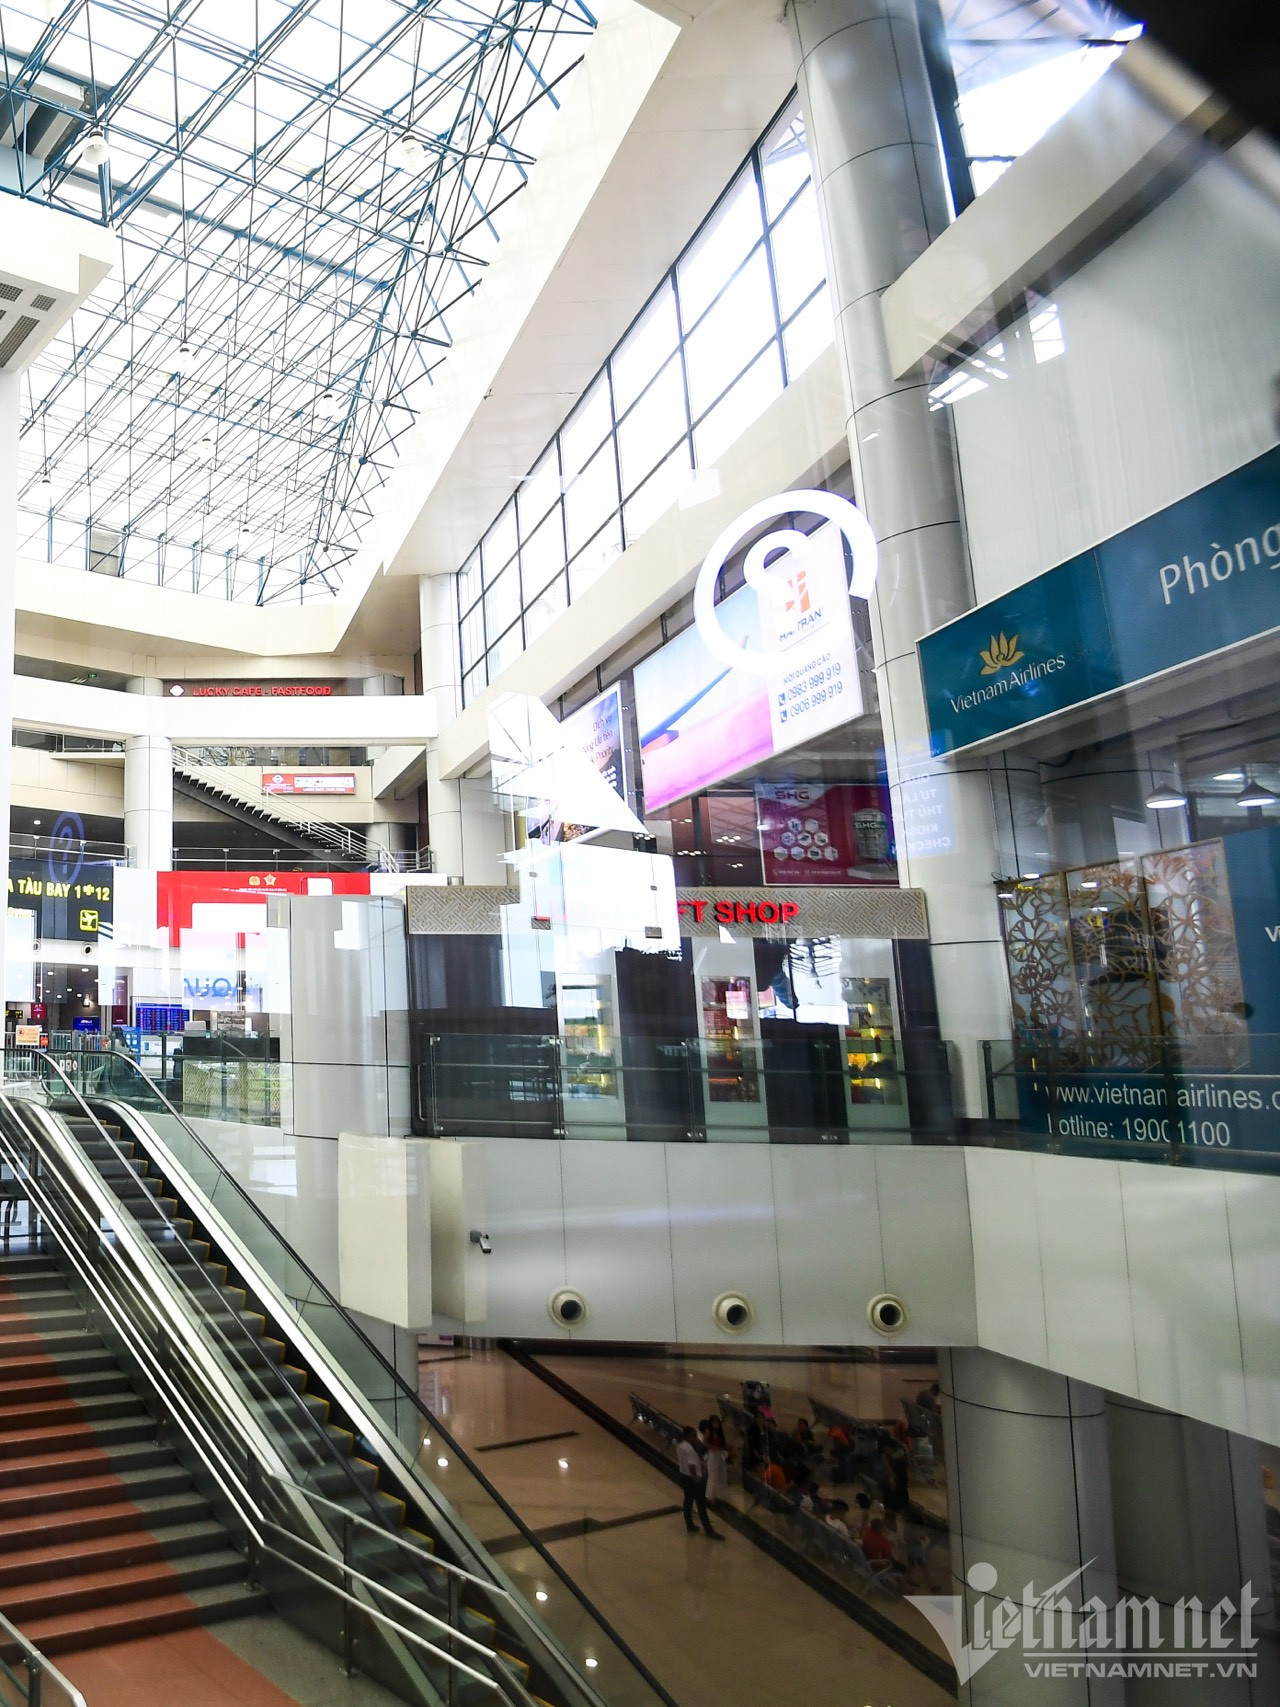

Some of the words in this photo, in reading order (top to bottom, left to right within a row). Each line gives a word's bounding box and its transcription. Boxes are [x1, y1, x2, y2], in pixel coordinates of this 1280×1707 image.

[1159, 523, 1280, 604] Phòng
[192, 686, 229, 696] LUCKY
[232, 686, 262, 696] CAFE
[271, 686, 333, 696] FASTFOOD
[787, 681, 807, 701] 0983
[808, 672, 825, 689] 999
[826, 662, 841, 680] 919
[790, 698, 810, 717] 0906
[811, 689, 827, 707] 999
[827, 681, 843, 698] 919
[774, 790, 810, 801] SHG
[18, 876, 42, 896] TÀU
[46, 881, 71, 898] BAY
[74, 884, 81, 899] 1
[95, 886, 110, 901] 12
[715, 899, 800, 924] SHOP
